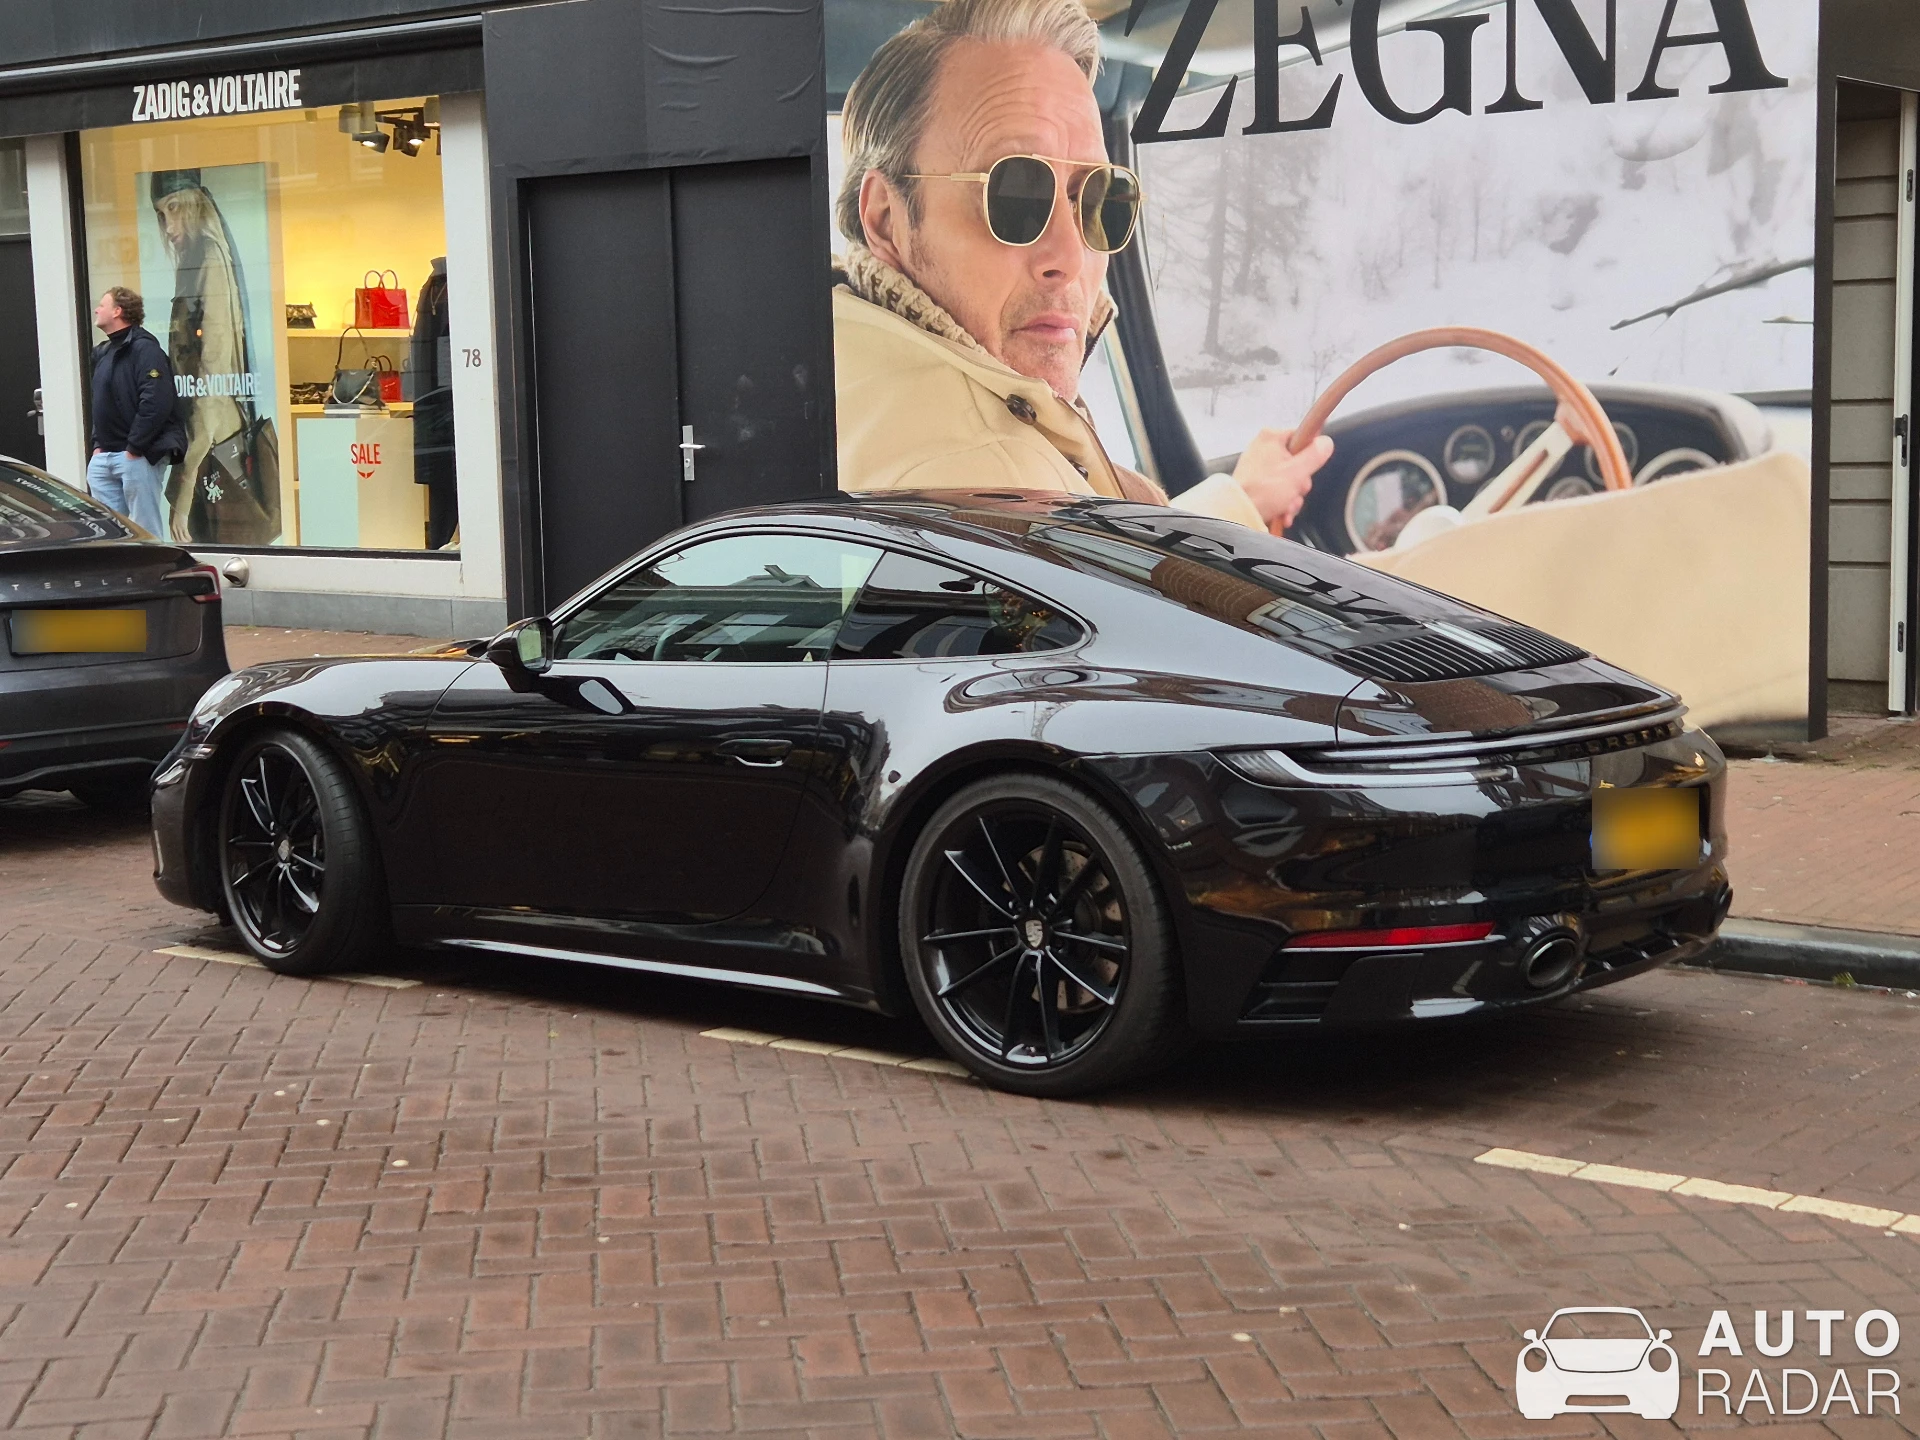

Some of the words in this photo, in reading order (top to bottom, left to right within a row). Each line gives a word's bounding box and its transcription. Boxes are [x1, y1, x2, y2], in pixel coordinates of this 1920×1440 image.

[1123, 0, 1789, 144] ZEGNA
[132, 69, 302, 122] ZADIG&VOLTAIRE
[461, 348, 482, 368] 78
[173, 372, 263, 398] DIG&VOLTAIRE
[350, 443, 382, 465] SALE
[11, 577, 133, 592] TESLA
